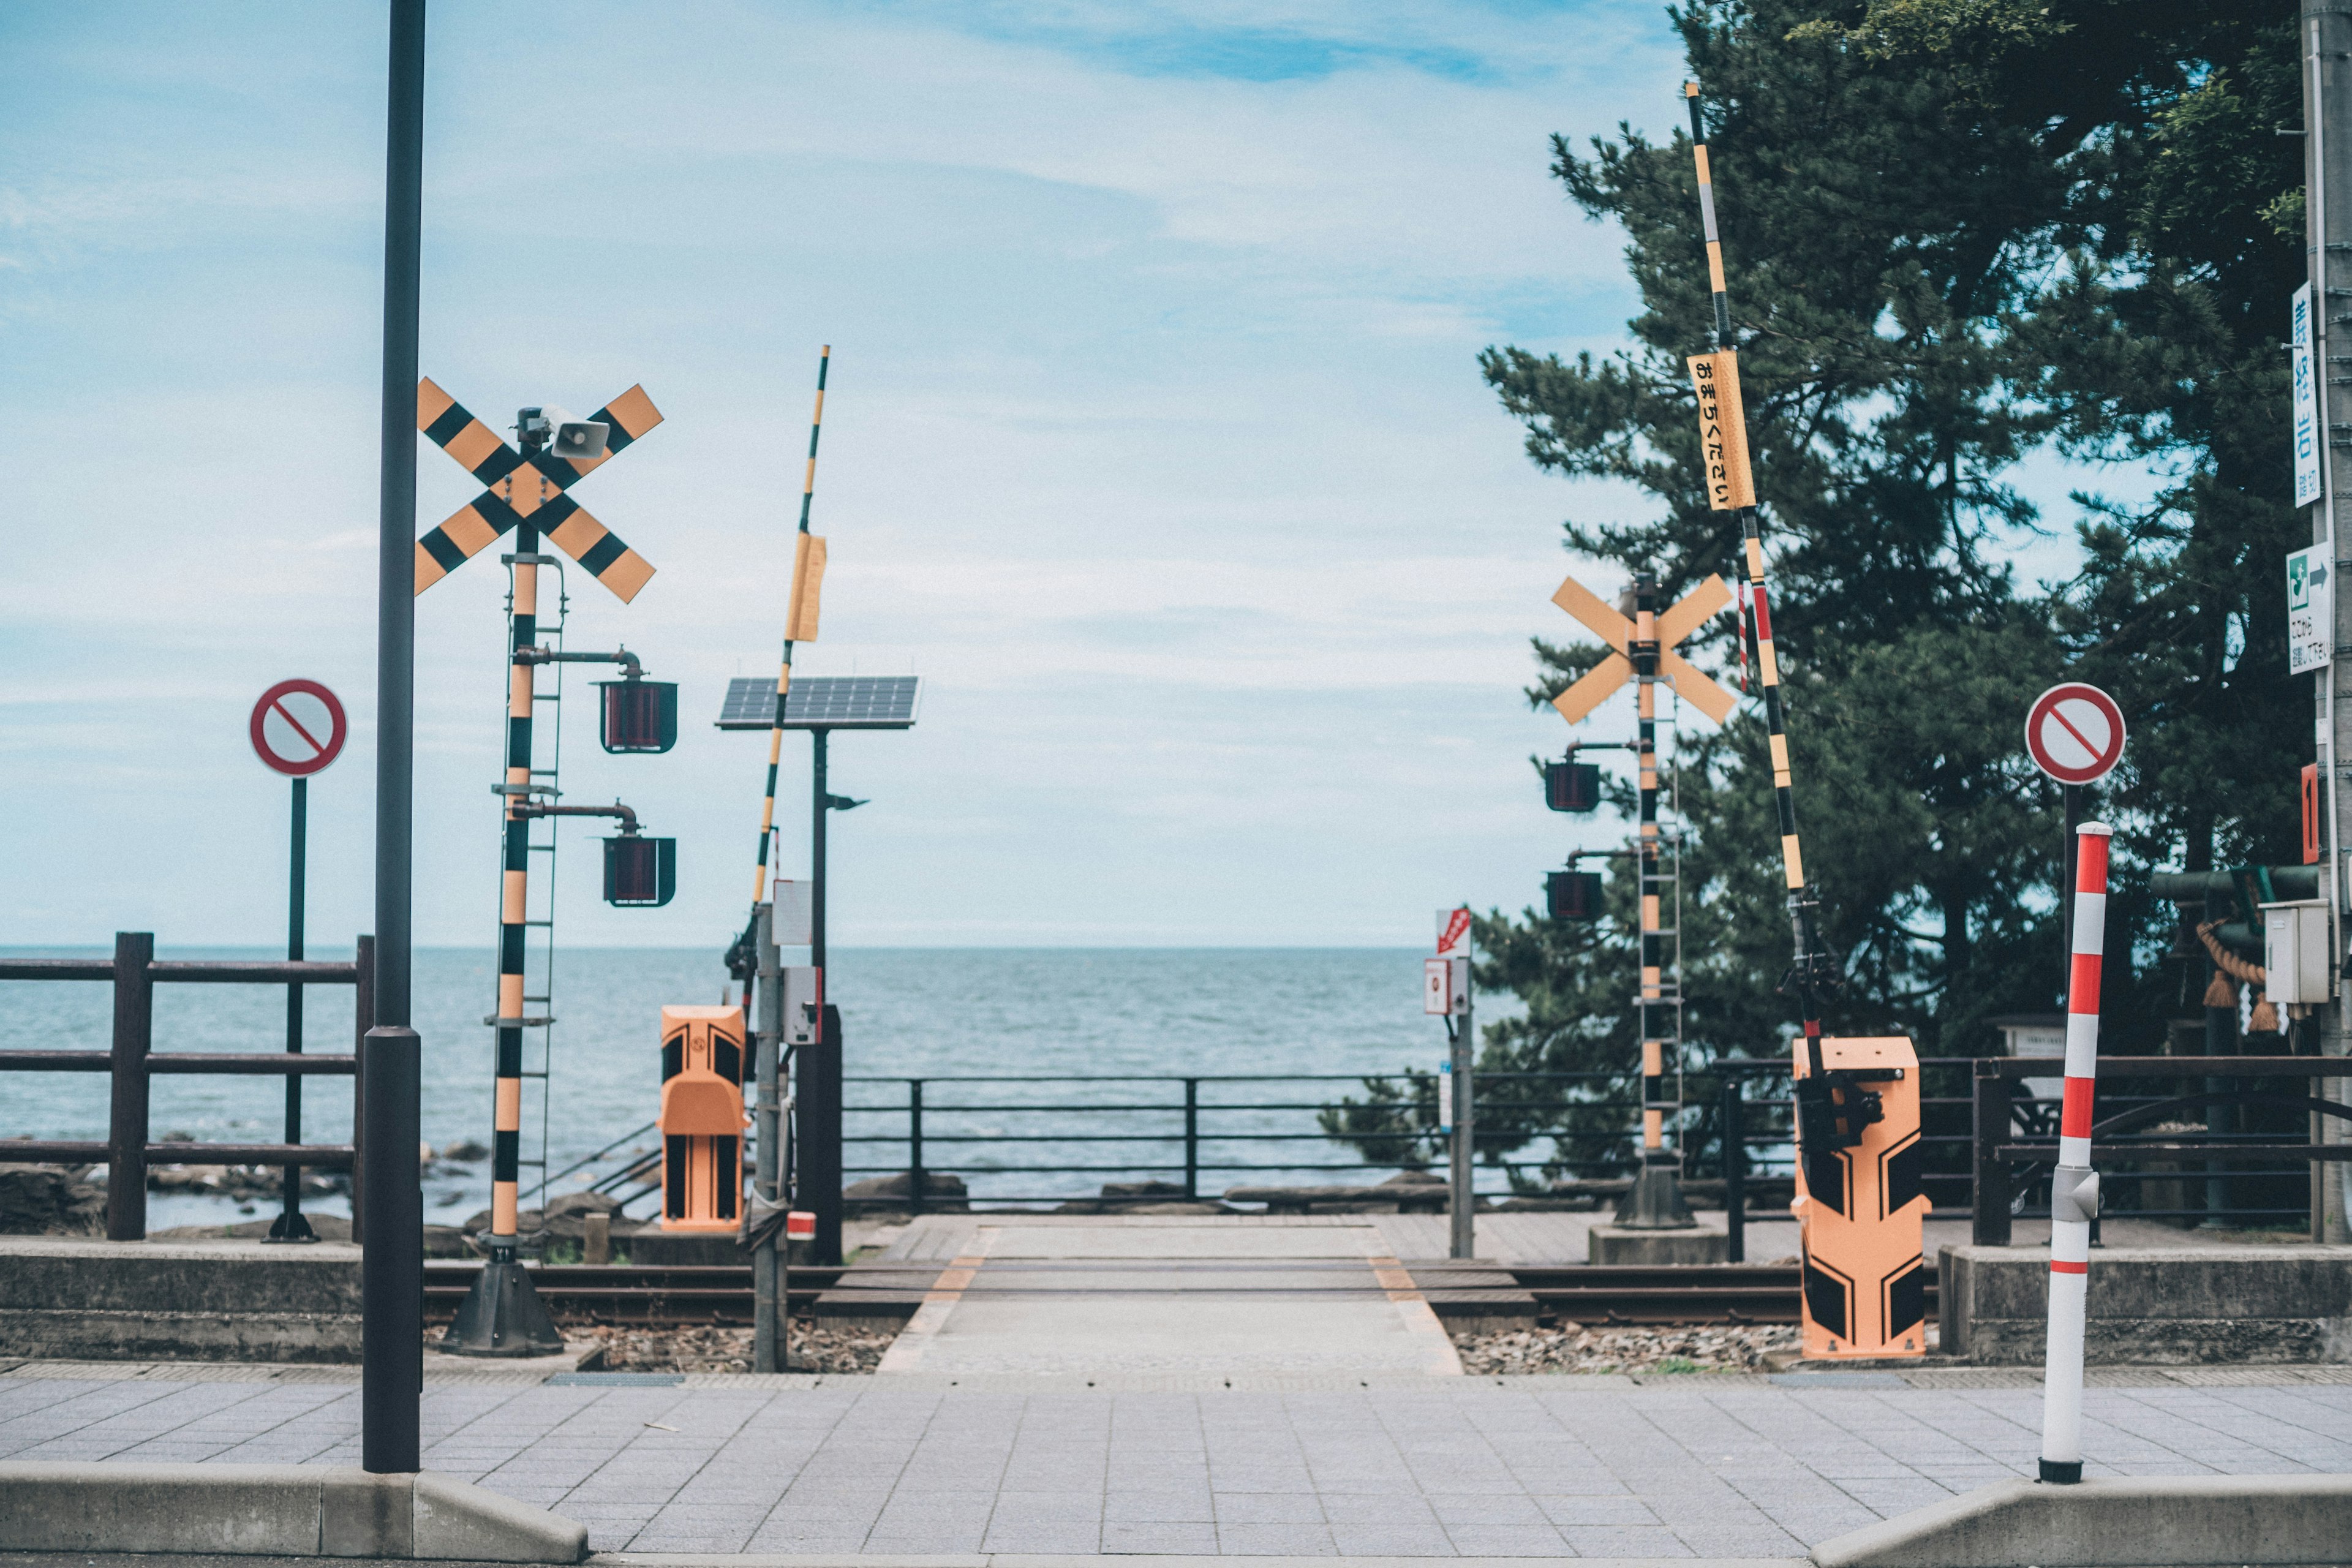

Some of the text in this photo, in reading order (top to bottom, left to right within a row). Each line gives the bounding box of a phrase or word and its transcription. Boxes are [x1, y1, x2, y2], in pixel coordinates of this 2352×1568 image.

[1696, 362, 1729, 503] おまちください
[2299, 469, 2317, 497] 踏切
[2292, 616, 2312, 639] ここから
[2306, 779, 2312, 849] 1
